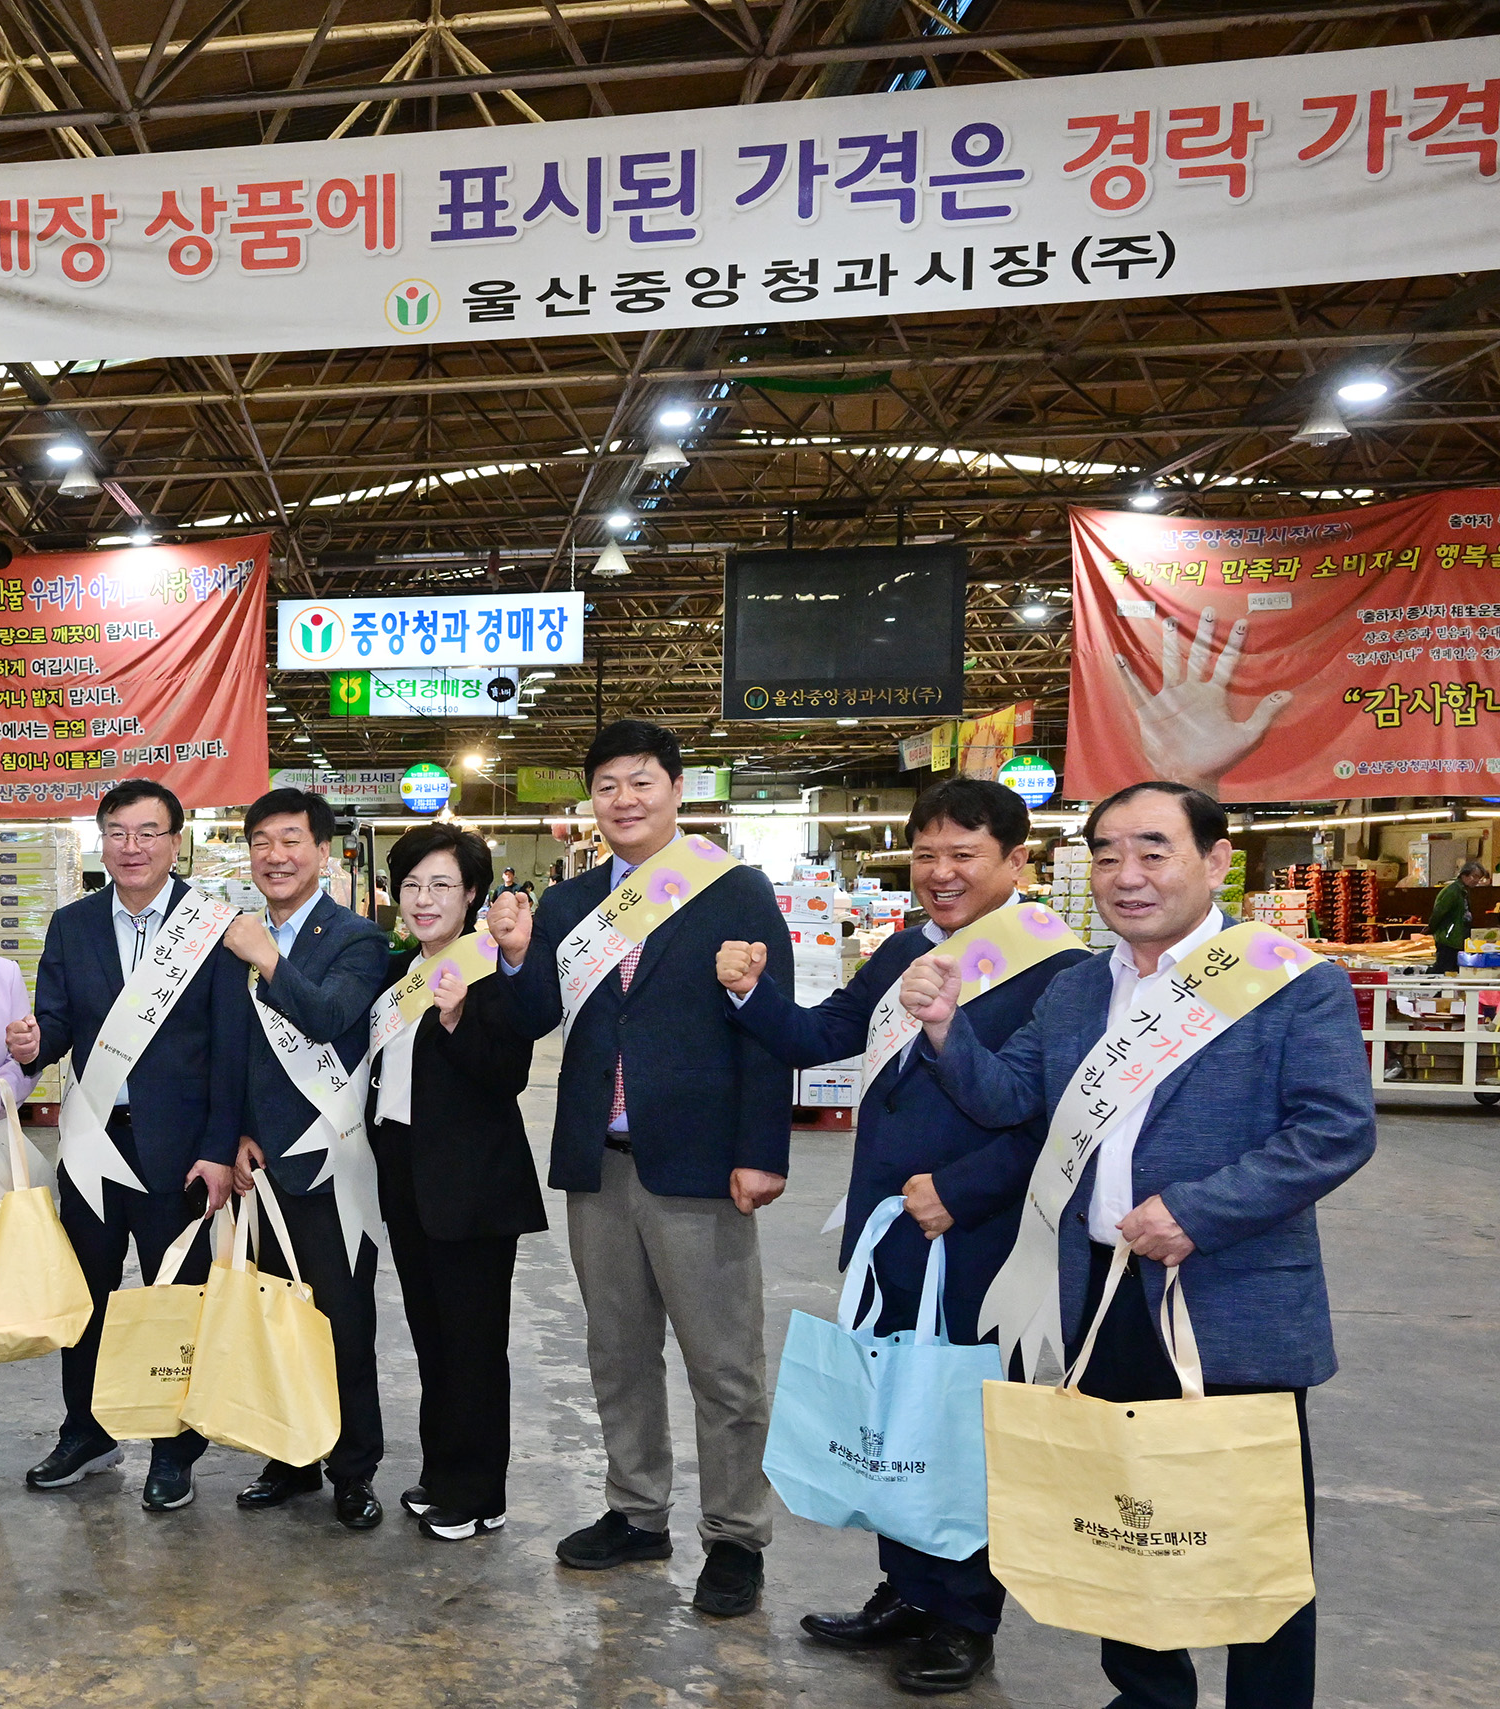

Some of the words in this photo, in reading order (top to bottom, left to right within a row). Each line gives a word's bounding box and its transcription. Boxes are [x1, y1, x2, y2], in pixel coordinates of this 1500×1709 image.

[143, 170, 400, 280] 상품에
[428, 143, 699, 247] 표시된
[734, 120, 1026, 226] 가격은
[1062, 99, 1267, 212] 경락
[1296, 80, 1500, 178] 가격
[463, 230, 1177, 325] 울산중앙청과시장(주)
[1449, 514, 1492, 529] 출하자
[1161, 522, 1353, 550] 산중앙청과시장(주)
[1221, 556, 1302, 584] 만족과
[1311, 546, 1421, 579] 소비자의
[28, 575, 84, 612] 우리가
[50, 624, 101, 644] 깨끗이
[106, 621, 160, 641] 합시다.
[31, 656, 101, 676] 여깁시다.
[68, 687, 122, 706] 맙시다.
[374, 678, 482, 698] 농협경매장
[771, 686, 943, 707] 울산중앙청과시장(주)
[53, 719, 86, 739] 금연
[91, 717, 145, 737] 합시다.
[1, 751, 49, 771] 침이나
[53, 749, 117, 771] 이물질을
[122, 746, 170, 766] 버리지
[174, 743, 228, 763] 맙시다.
[360, 772, 395, 783] 표시된
[415, 783, 449, 792] 과일나라
[1017, 777, 1055, 788] 정원유통
[331, 784, 400, 794] 낙찰가격입니
[372, 1013, 403, 1048] 한가
[829, 1440, 926, 1474] 울산농수산물도매시장
[1073, 1517, 1207, 1547] 울산농수산물도매시장
